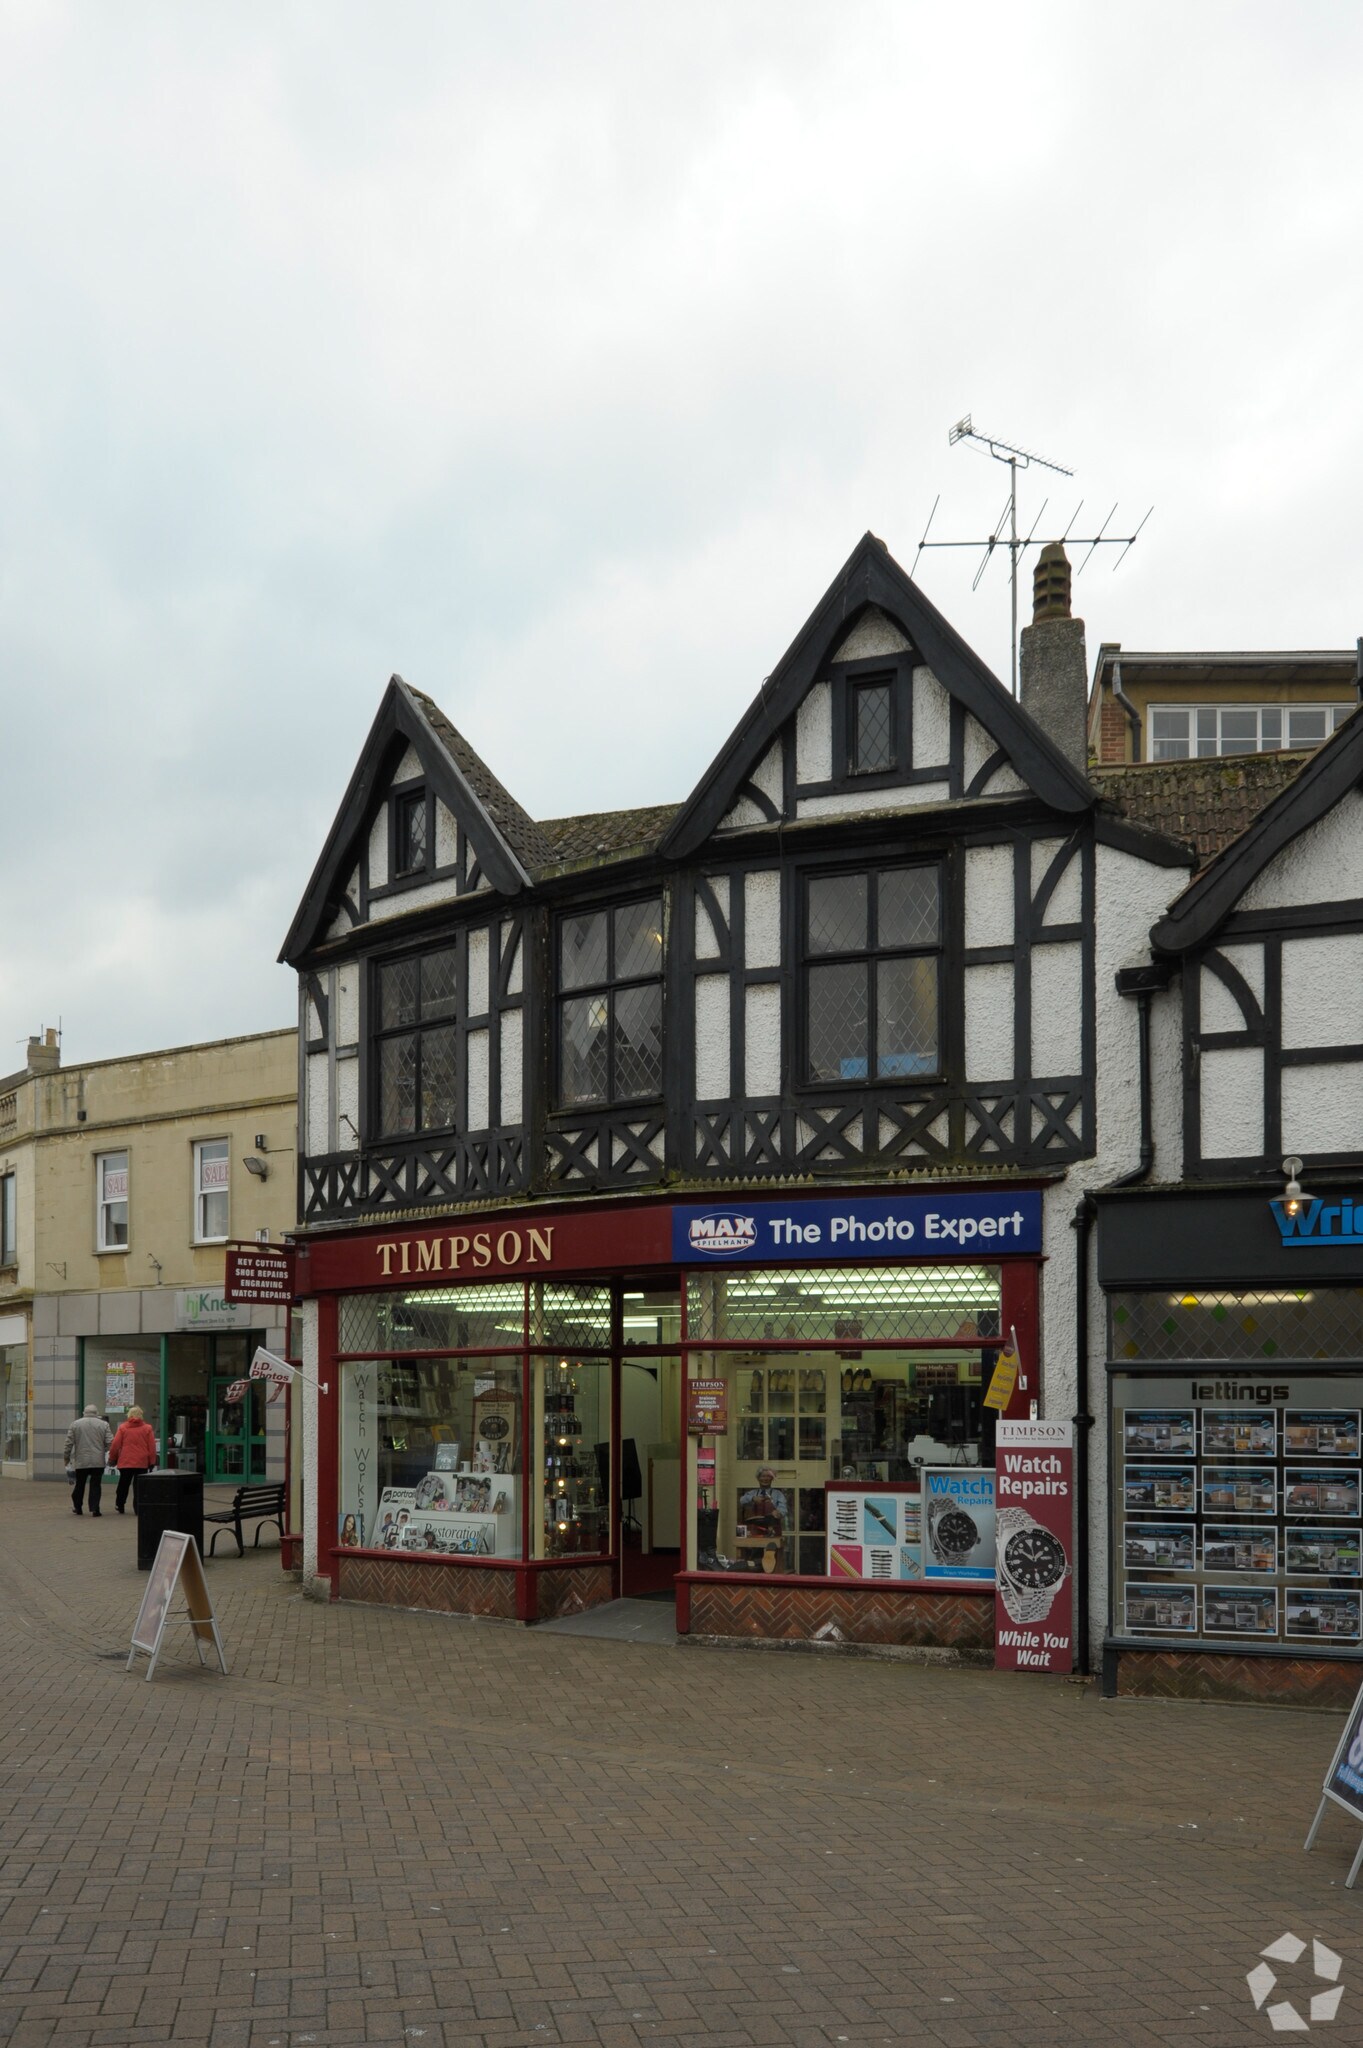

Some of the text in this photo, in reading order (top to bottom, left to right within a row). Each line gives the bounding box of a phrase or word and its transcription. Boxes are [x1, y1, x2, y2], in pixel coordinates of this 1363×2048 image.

[691, 1218, 755, 1238] MAX
[769, 1211, 1024, 1245] The Photo Expert
[697, 1239, 749, 1247] SPIELMANN
[376, 1227, 555, 1275] TIMPSON
[237, 1258, 287, 1269] KEY CUTTING
[235, 1268, 289, 1279] SHOE REPAIRS
[240, 1279, 283, 1289] ENGRAVING
[231, 1289, 291, 1300] WATCH REPAIRS
[107, 1362, 123, 1370] SALE
[253, 1361, 273, 1371] I.D.
[251, 1370, 290, 1381] Photos
[1192, 1382, 1290, 1405] lettings
[1001, 1426, 1066, 1437] TIMPSON
[1004, 1455, 1062, 1474] Watch
[929, 1476, 993, 1495] Watch
[1000, 1476, 1068, 1500] Repairs
[957, 1496, 993, 1506] Repairs
[999, 1631, 1069, 1649] While You
[1017, 1650, 1052, 1666] Wait
